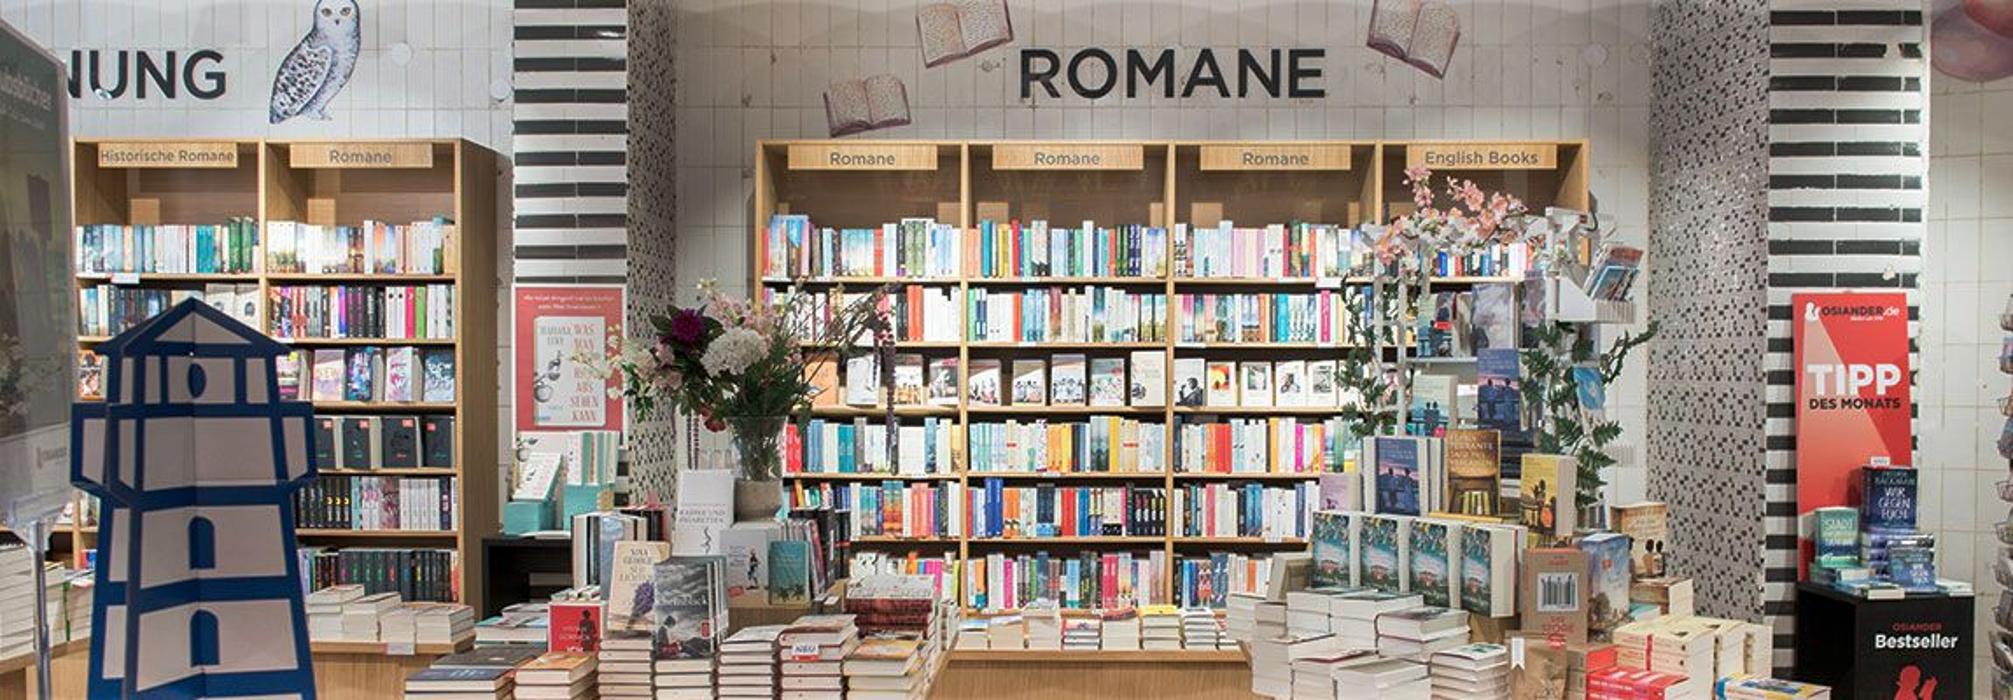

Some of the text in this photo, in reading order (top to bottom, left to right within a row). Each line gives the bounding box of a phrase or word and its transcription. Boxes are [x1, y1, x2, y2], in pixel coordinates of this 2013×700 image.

[1020, 48, 1326, 99] ROMANE
[101, 149, 235, 162] Historische Romane
[329, 149, 392, 163] Romane
[829, 151, 895, 165] Romane
[1034, 151, 1100, 165] Romane
[1242, 151, 1309, 165] Romane
[1425, 151, 1540, 167] English Books
[1807, 364, 1901, 396] TIPP
[1809, 398, 1901, 410] DES MONATS
[1884, 487, 1906, 498] WIR
[1878, 497, 1911, 509] GEGEN
[1875, 633, 1958, 649] Bestseller
